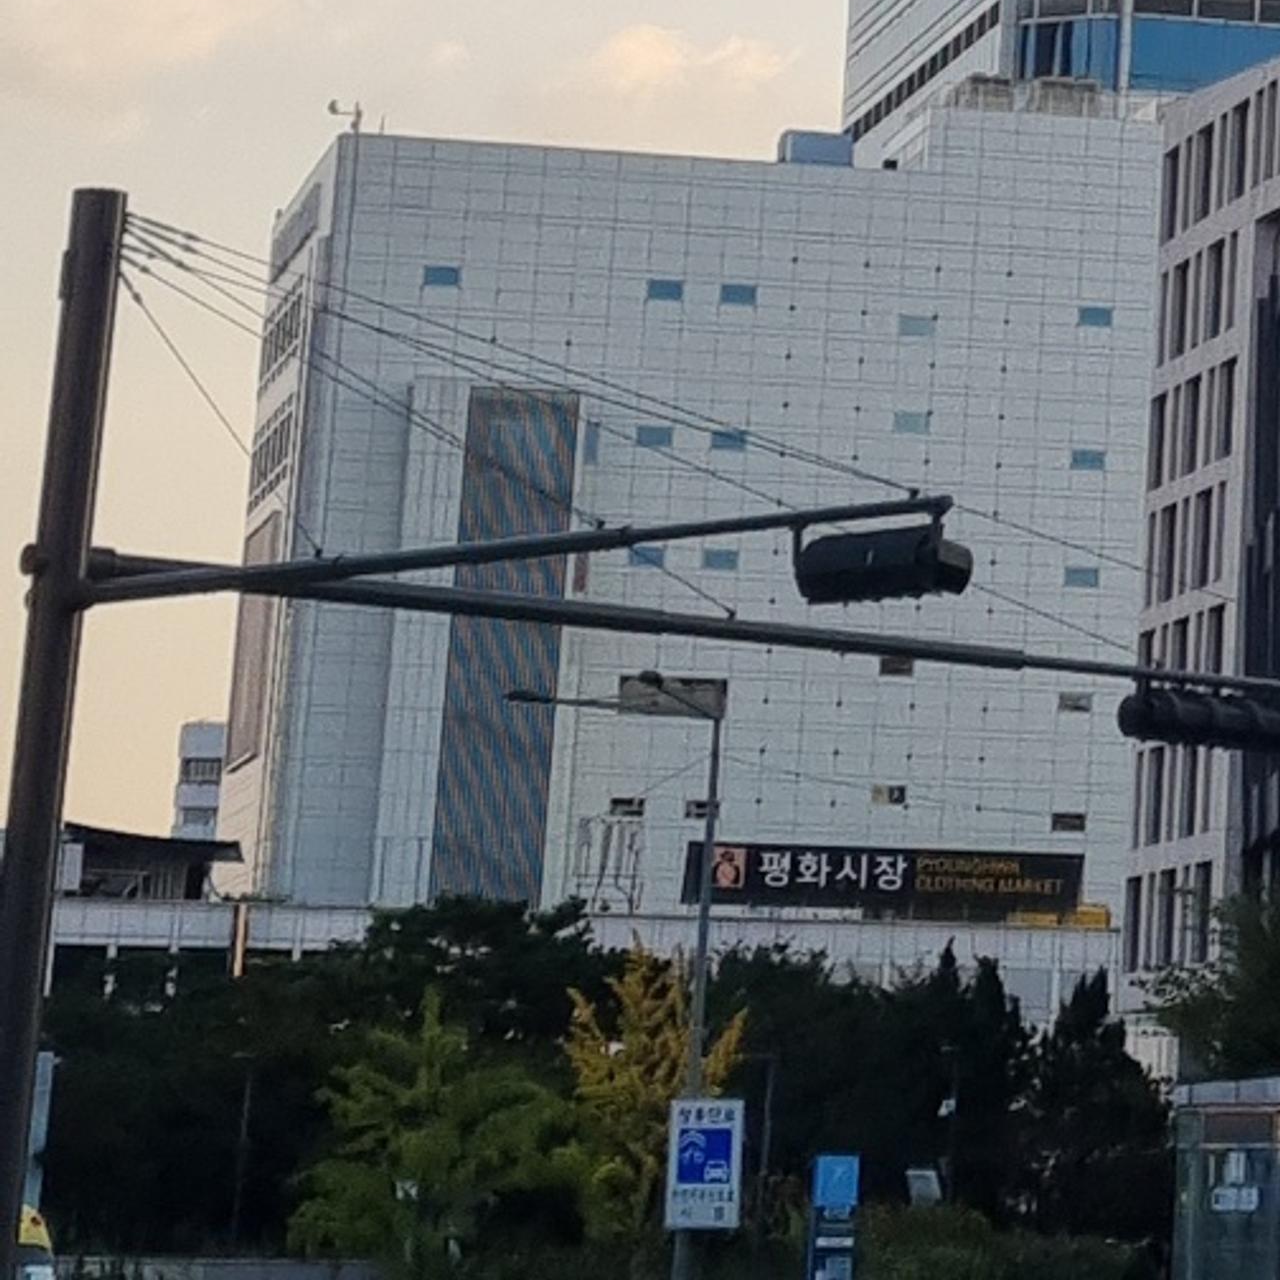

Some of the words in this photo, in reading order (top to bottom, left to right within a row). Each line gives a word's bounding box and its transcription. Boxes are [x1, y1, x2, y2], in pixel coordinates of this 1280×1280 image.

[758, 851, 908, 890] 평화시장
[915, 876, 993, 892] CLOTHING
[997, 878, 1064, 894] MARKET
